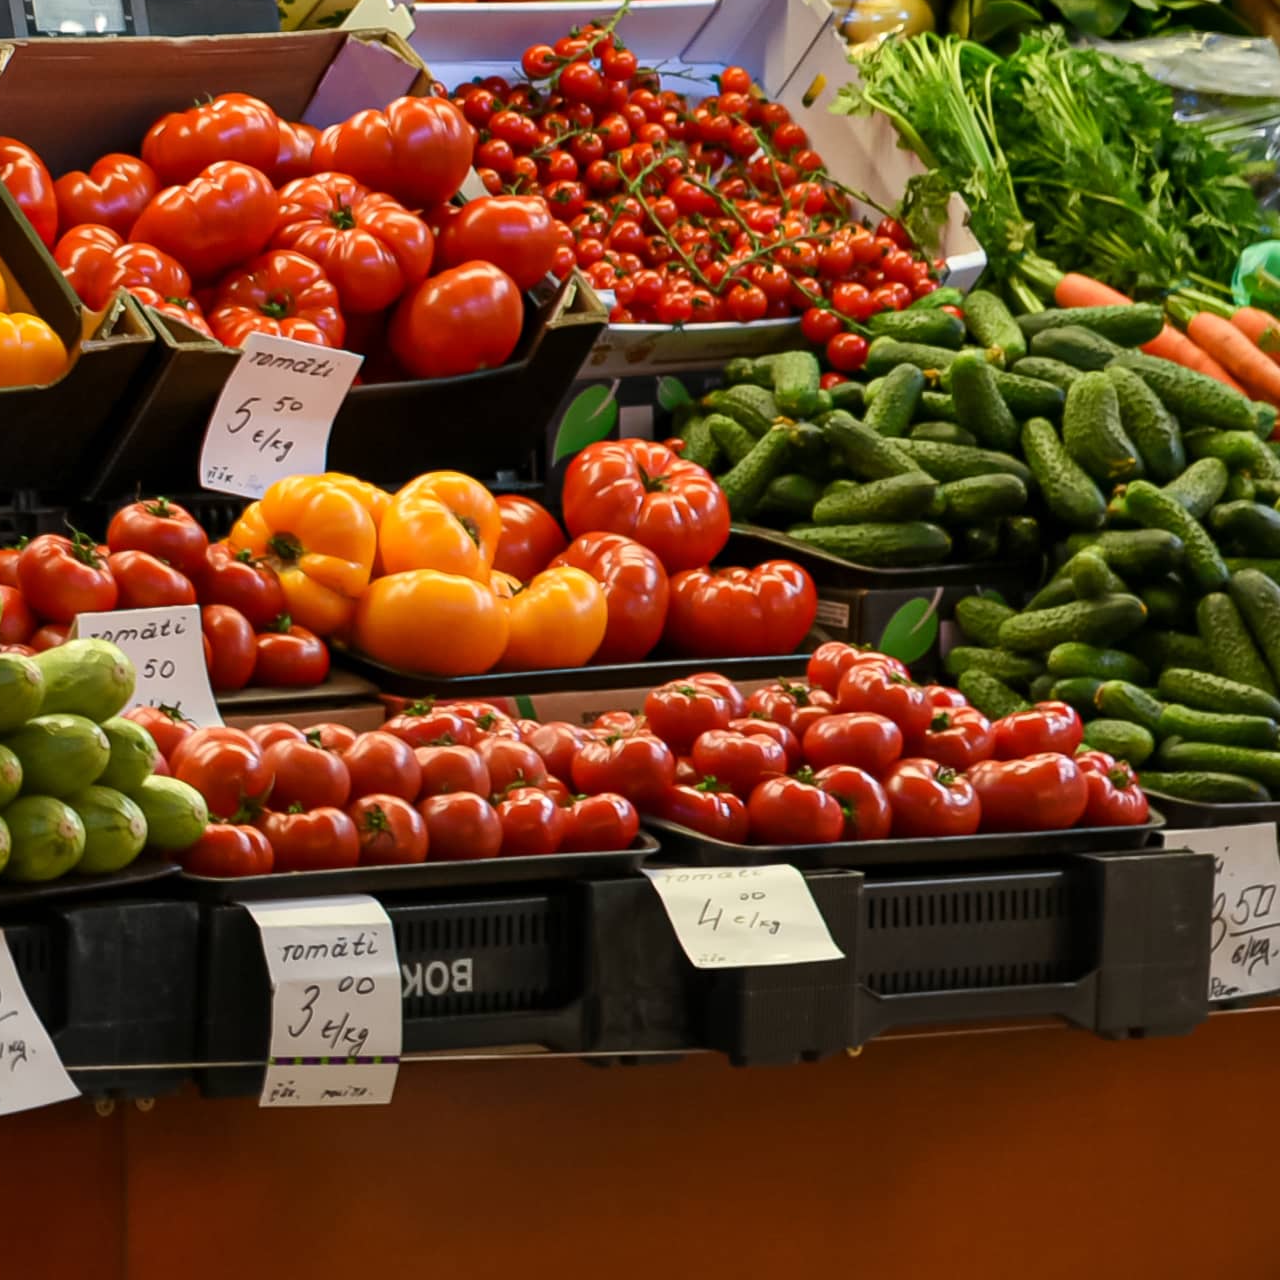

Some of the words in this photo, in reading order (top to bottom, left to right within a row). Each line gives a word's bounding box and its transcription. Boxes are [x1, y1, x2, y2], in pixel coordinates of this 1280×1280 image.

[226, 396, 262, 434] 5
[272, 395, 304, 412] 50
[143, 658, 176, 679] 50
[697, 898, 724, 932] 4
[287, 984, 321, 1038] 3
[337, 975, 376, 995] 00
